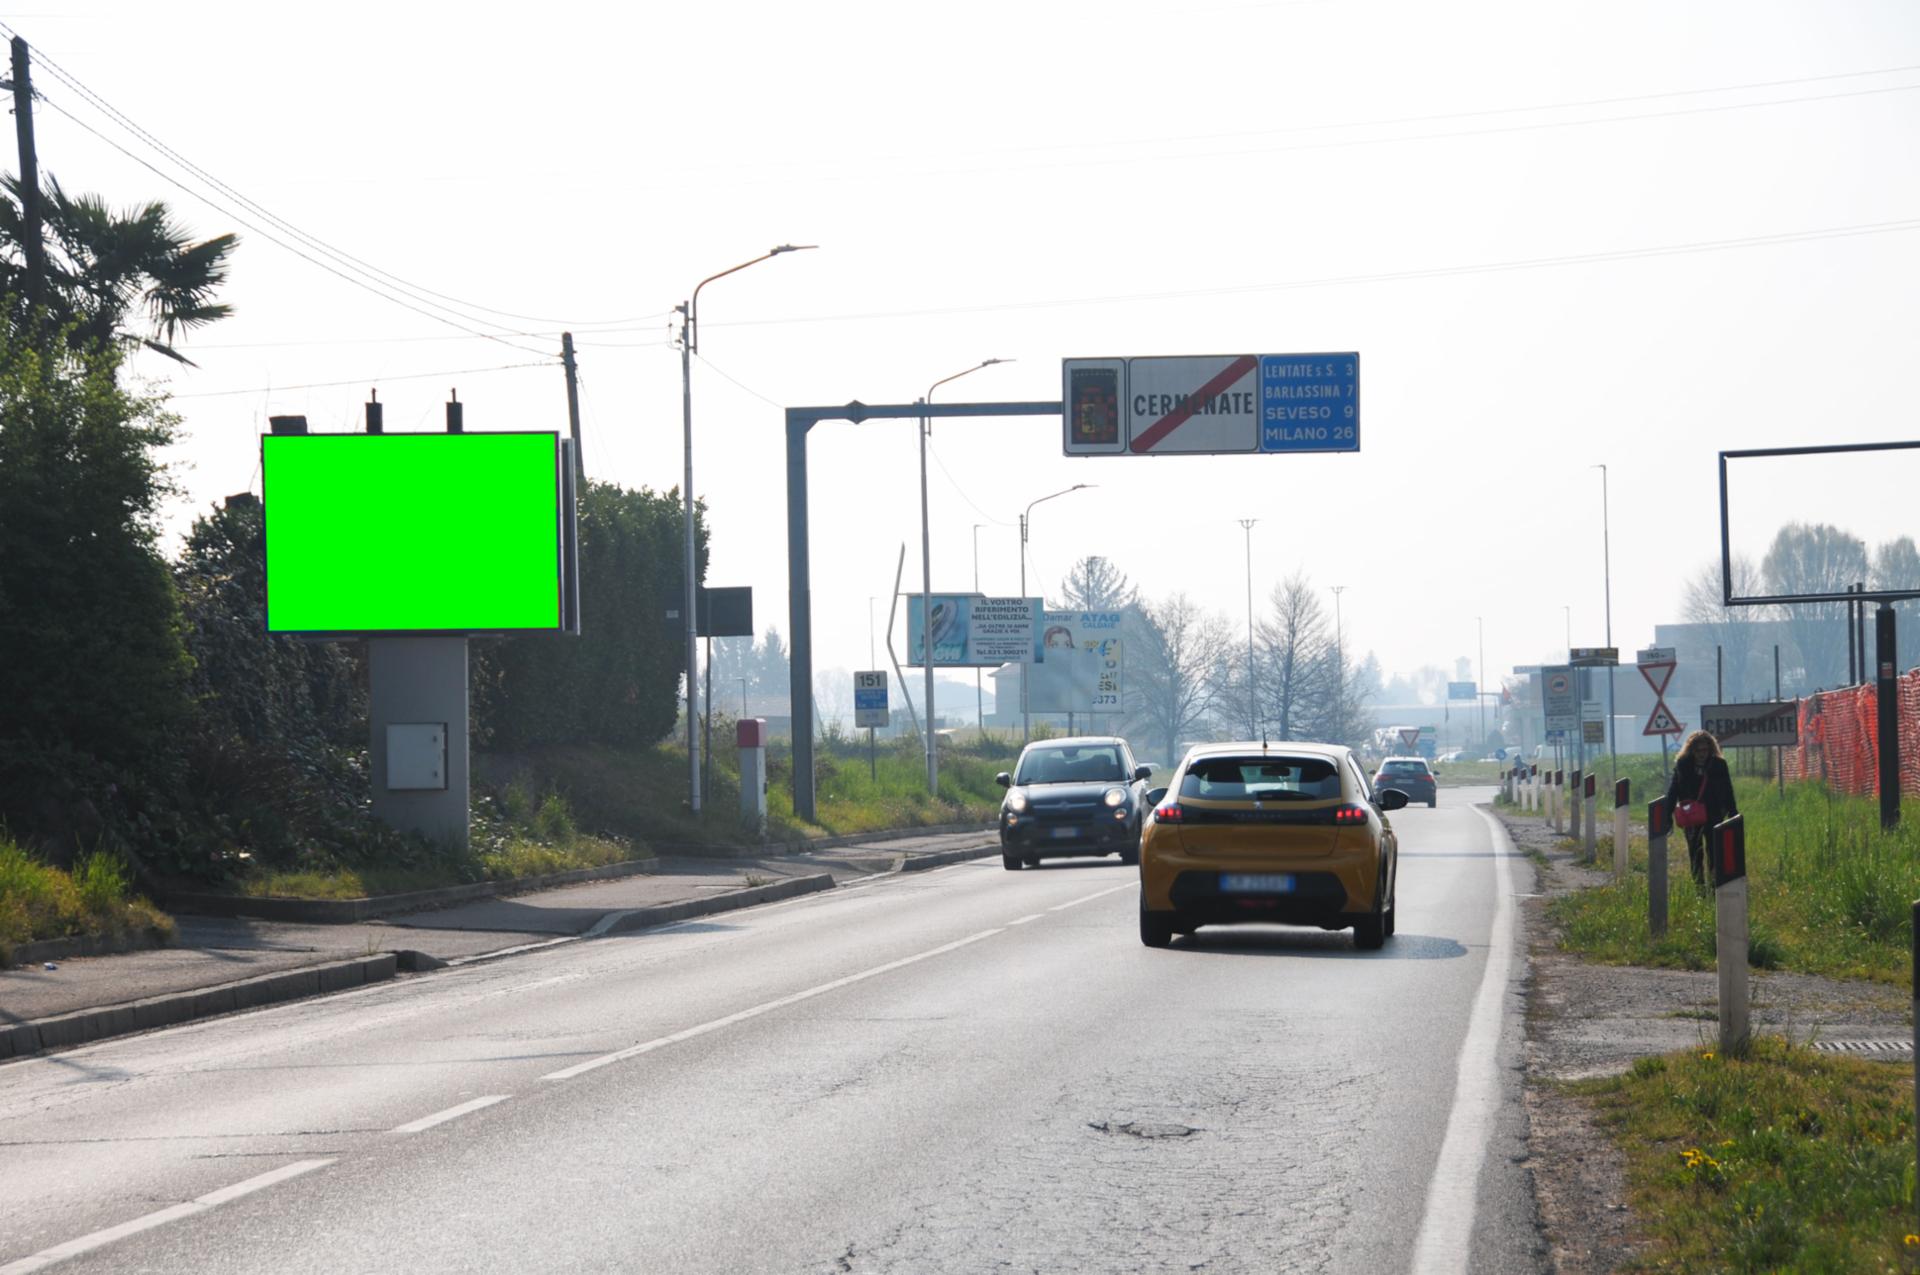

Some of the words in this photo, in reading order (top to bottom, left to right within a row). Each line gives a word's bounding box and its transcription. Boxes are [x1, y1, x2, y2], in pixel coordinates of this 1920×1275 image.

[1265, 364, 1313, 378] LENTATE
[1346, 363, 1353, 376] 3
[1265, 385, 1340, 399] BARLASSINA
[1347, 384, 1354, 397] 7
[1134, 392, 1254, 416] CERMENATE
[1266, 406, 1331, 419] SEVESO
[1343, 405, 1353, 418] 9
[1265, 427, 1328, 441] MILANO
[1333, 426, 1354, 440] 26
[860, 674, 880, 687] 151
[1705, 716, 1795, 735] CERMENATE
